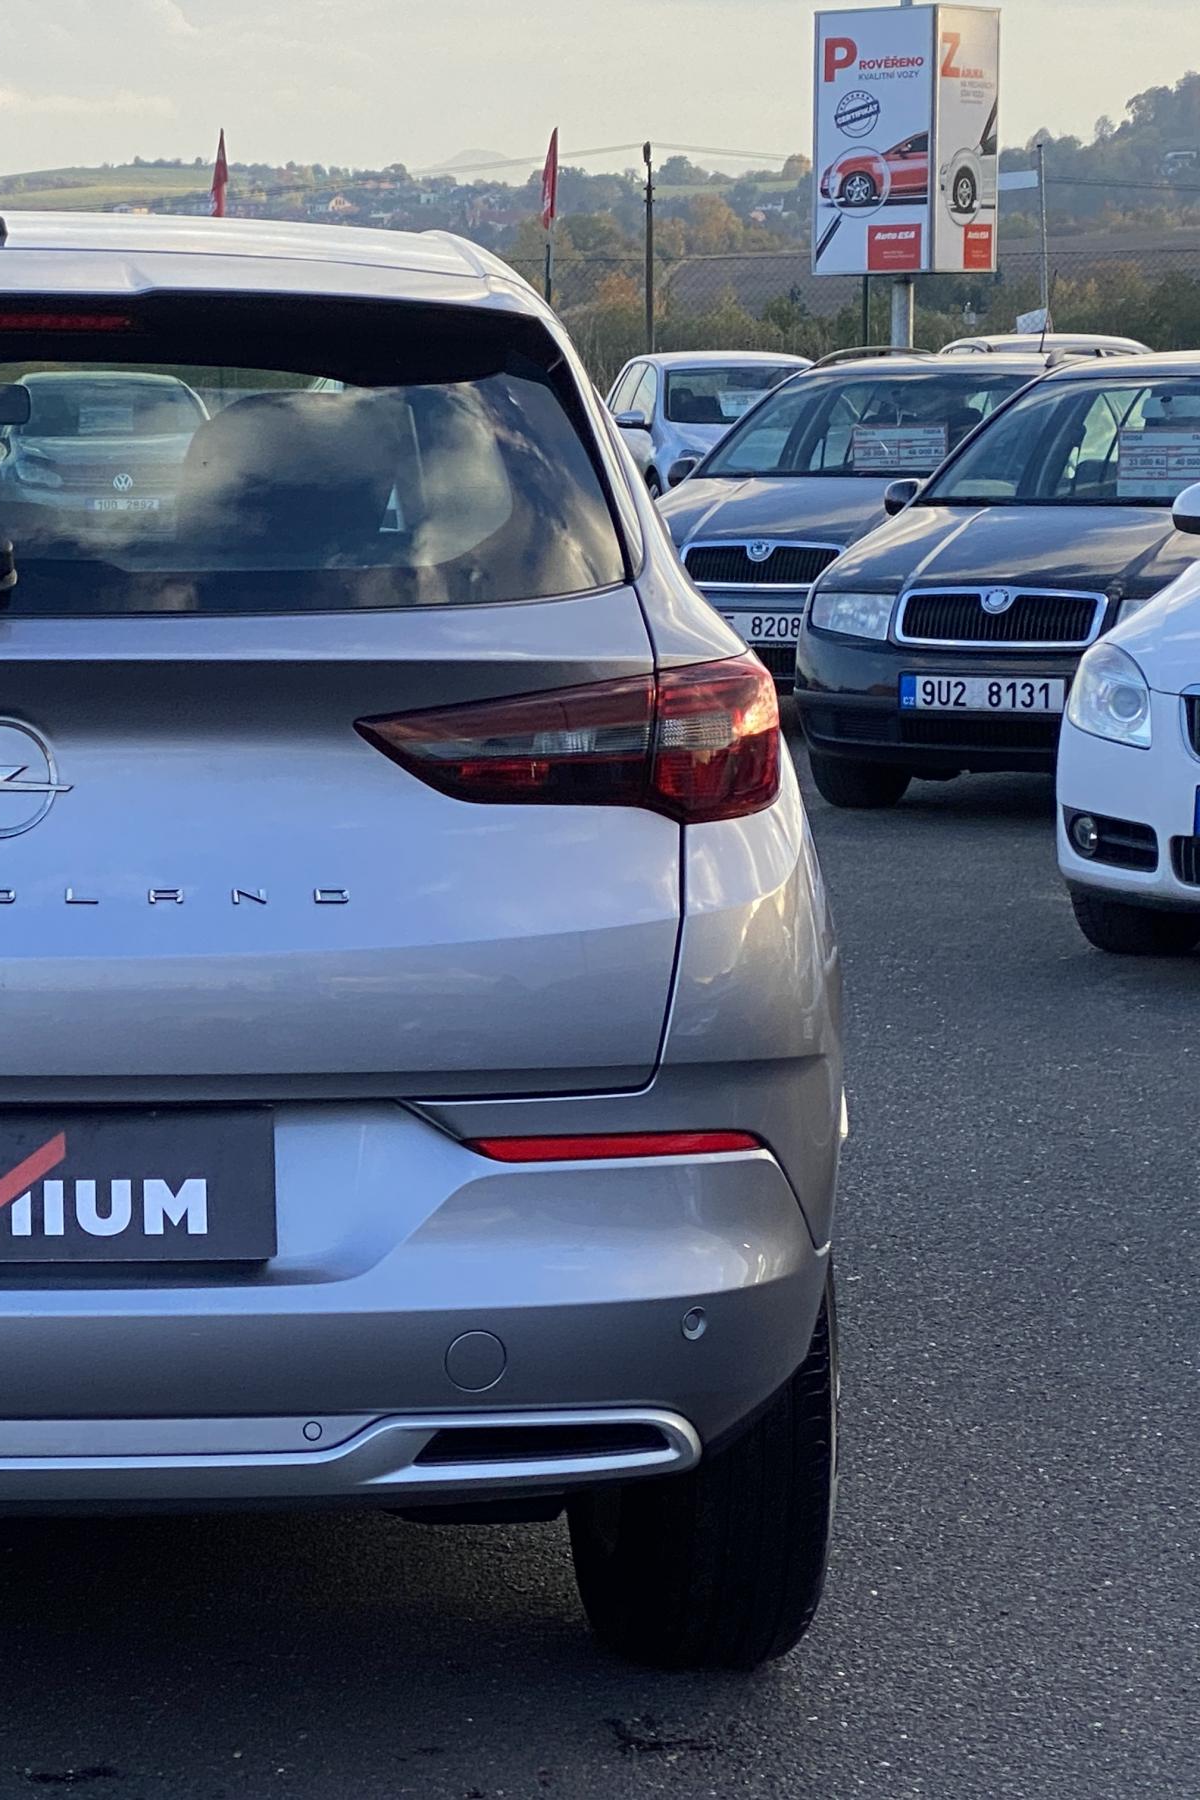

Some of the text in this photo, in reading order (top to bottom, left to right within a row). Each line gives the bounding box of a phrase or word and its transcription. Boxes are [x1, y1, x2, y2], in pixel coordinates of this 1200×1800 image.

[859, 71, 895, 80] KVALITNÍ
[874, 231, 915, 240] Auto ESA
[751, 615, 801, 638] 8208
[921, 680, 1050, 709] 9U2 8131
[903, 697, 915, 705] CZ
